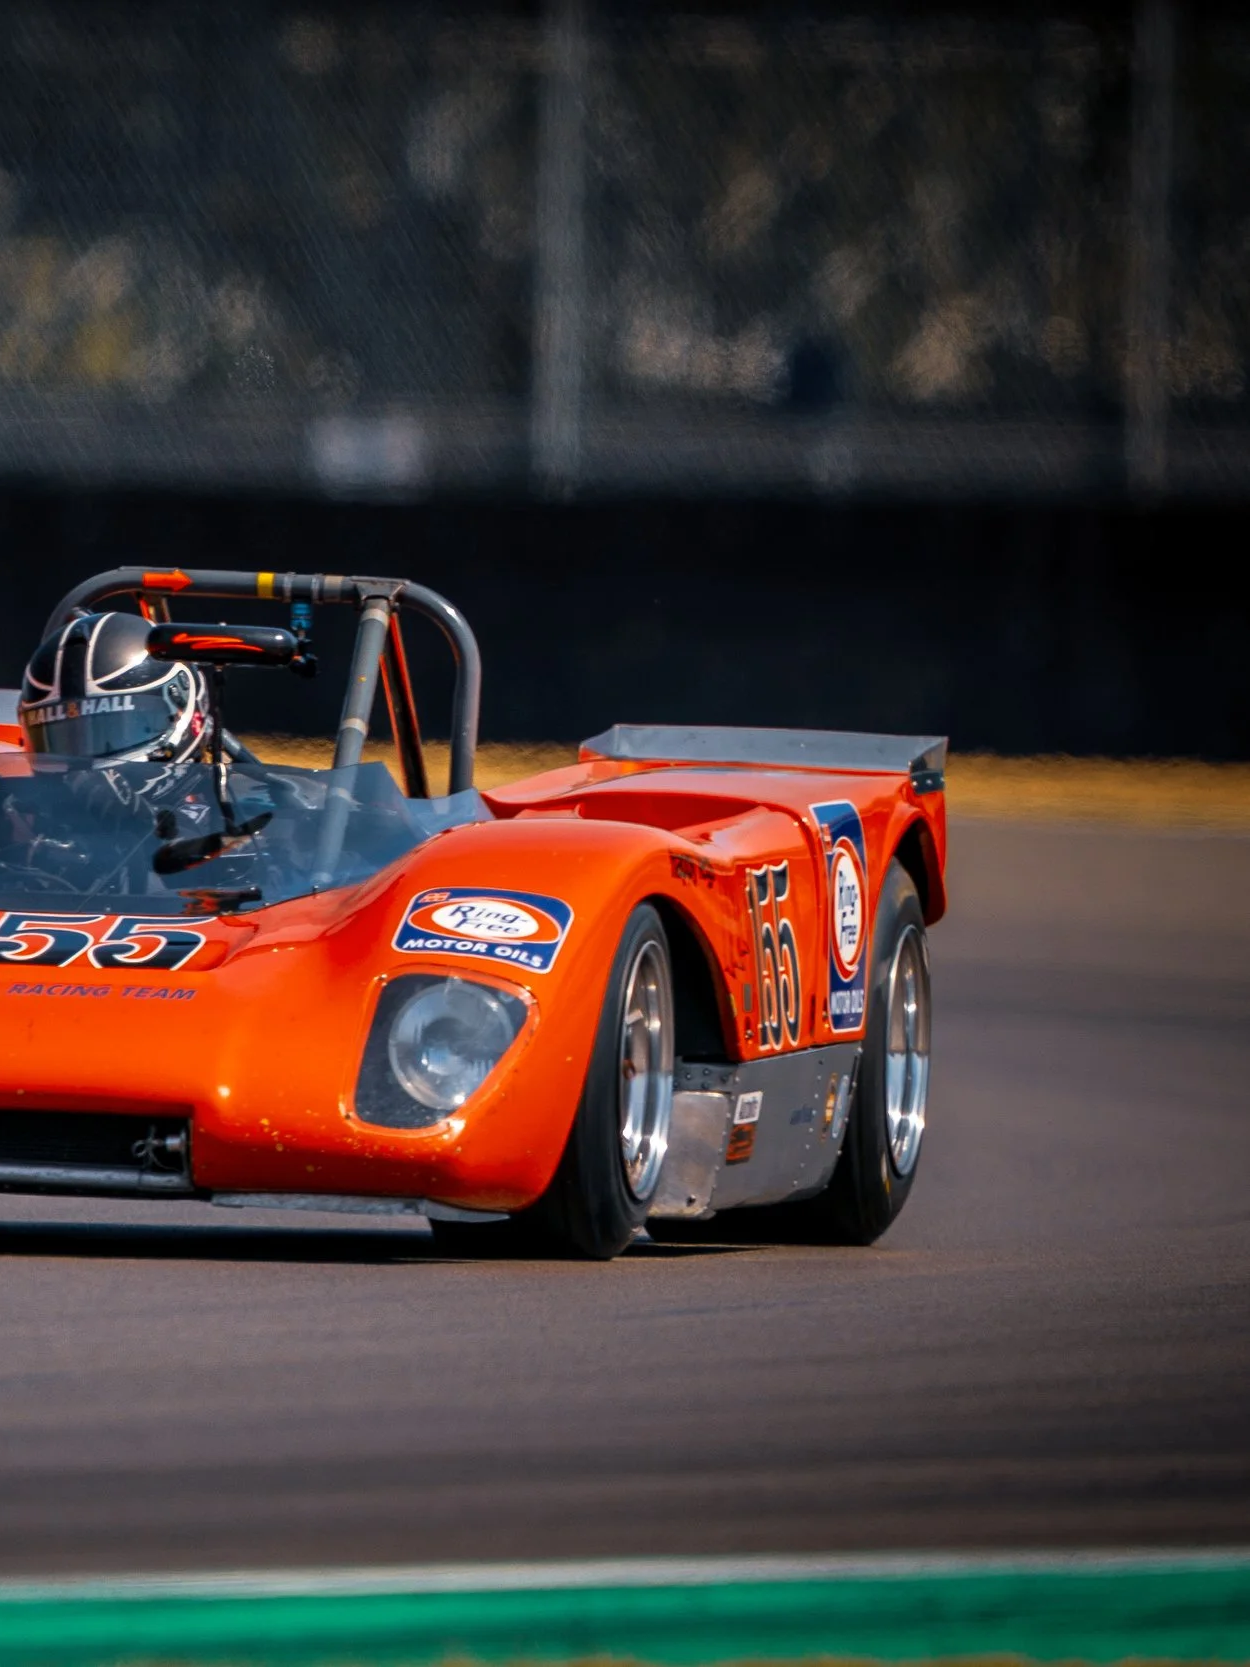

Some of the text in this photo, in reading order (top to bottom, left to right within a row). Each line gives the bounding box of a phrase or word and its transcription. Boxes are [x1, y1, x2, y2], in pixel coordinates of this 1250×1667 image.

[448, 905, 529, 924] Ring-
[454, 919, 520, 935] Free
[402, 938, 544, 968] MOTOR OILS
[745, 859, 802, 1050] 155
[8, 983, 113, 998] RACING
[121, 986, 198, 1001] TEAM
